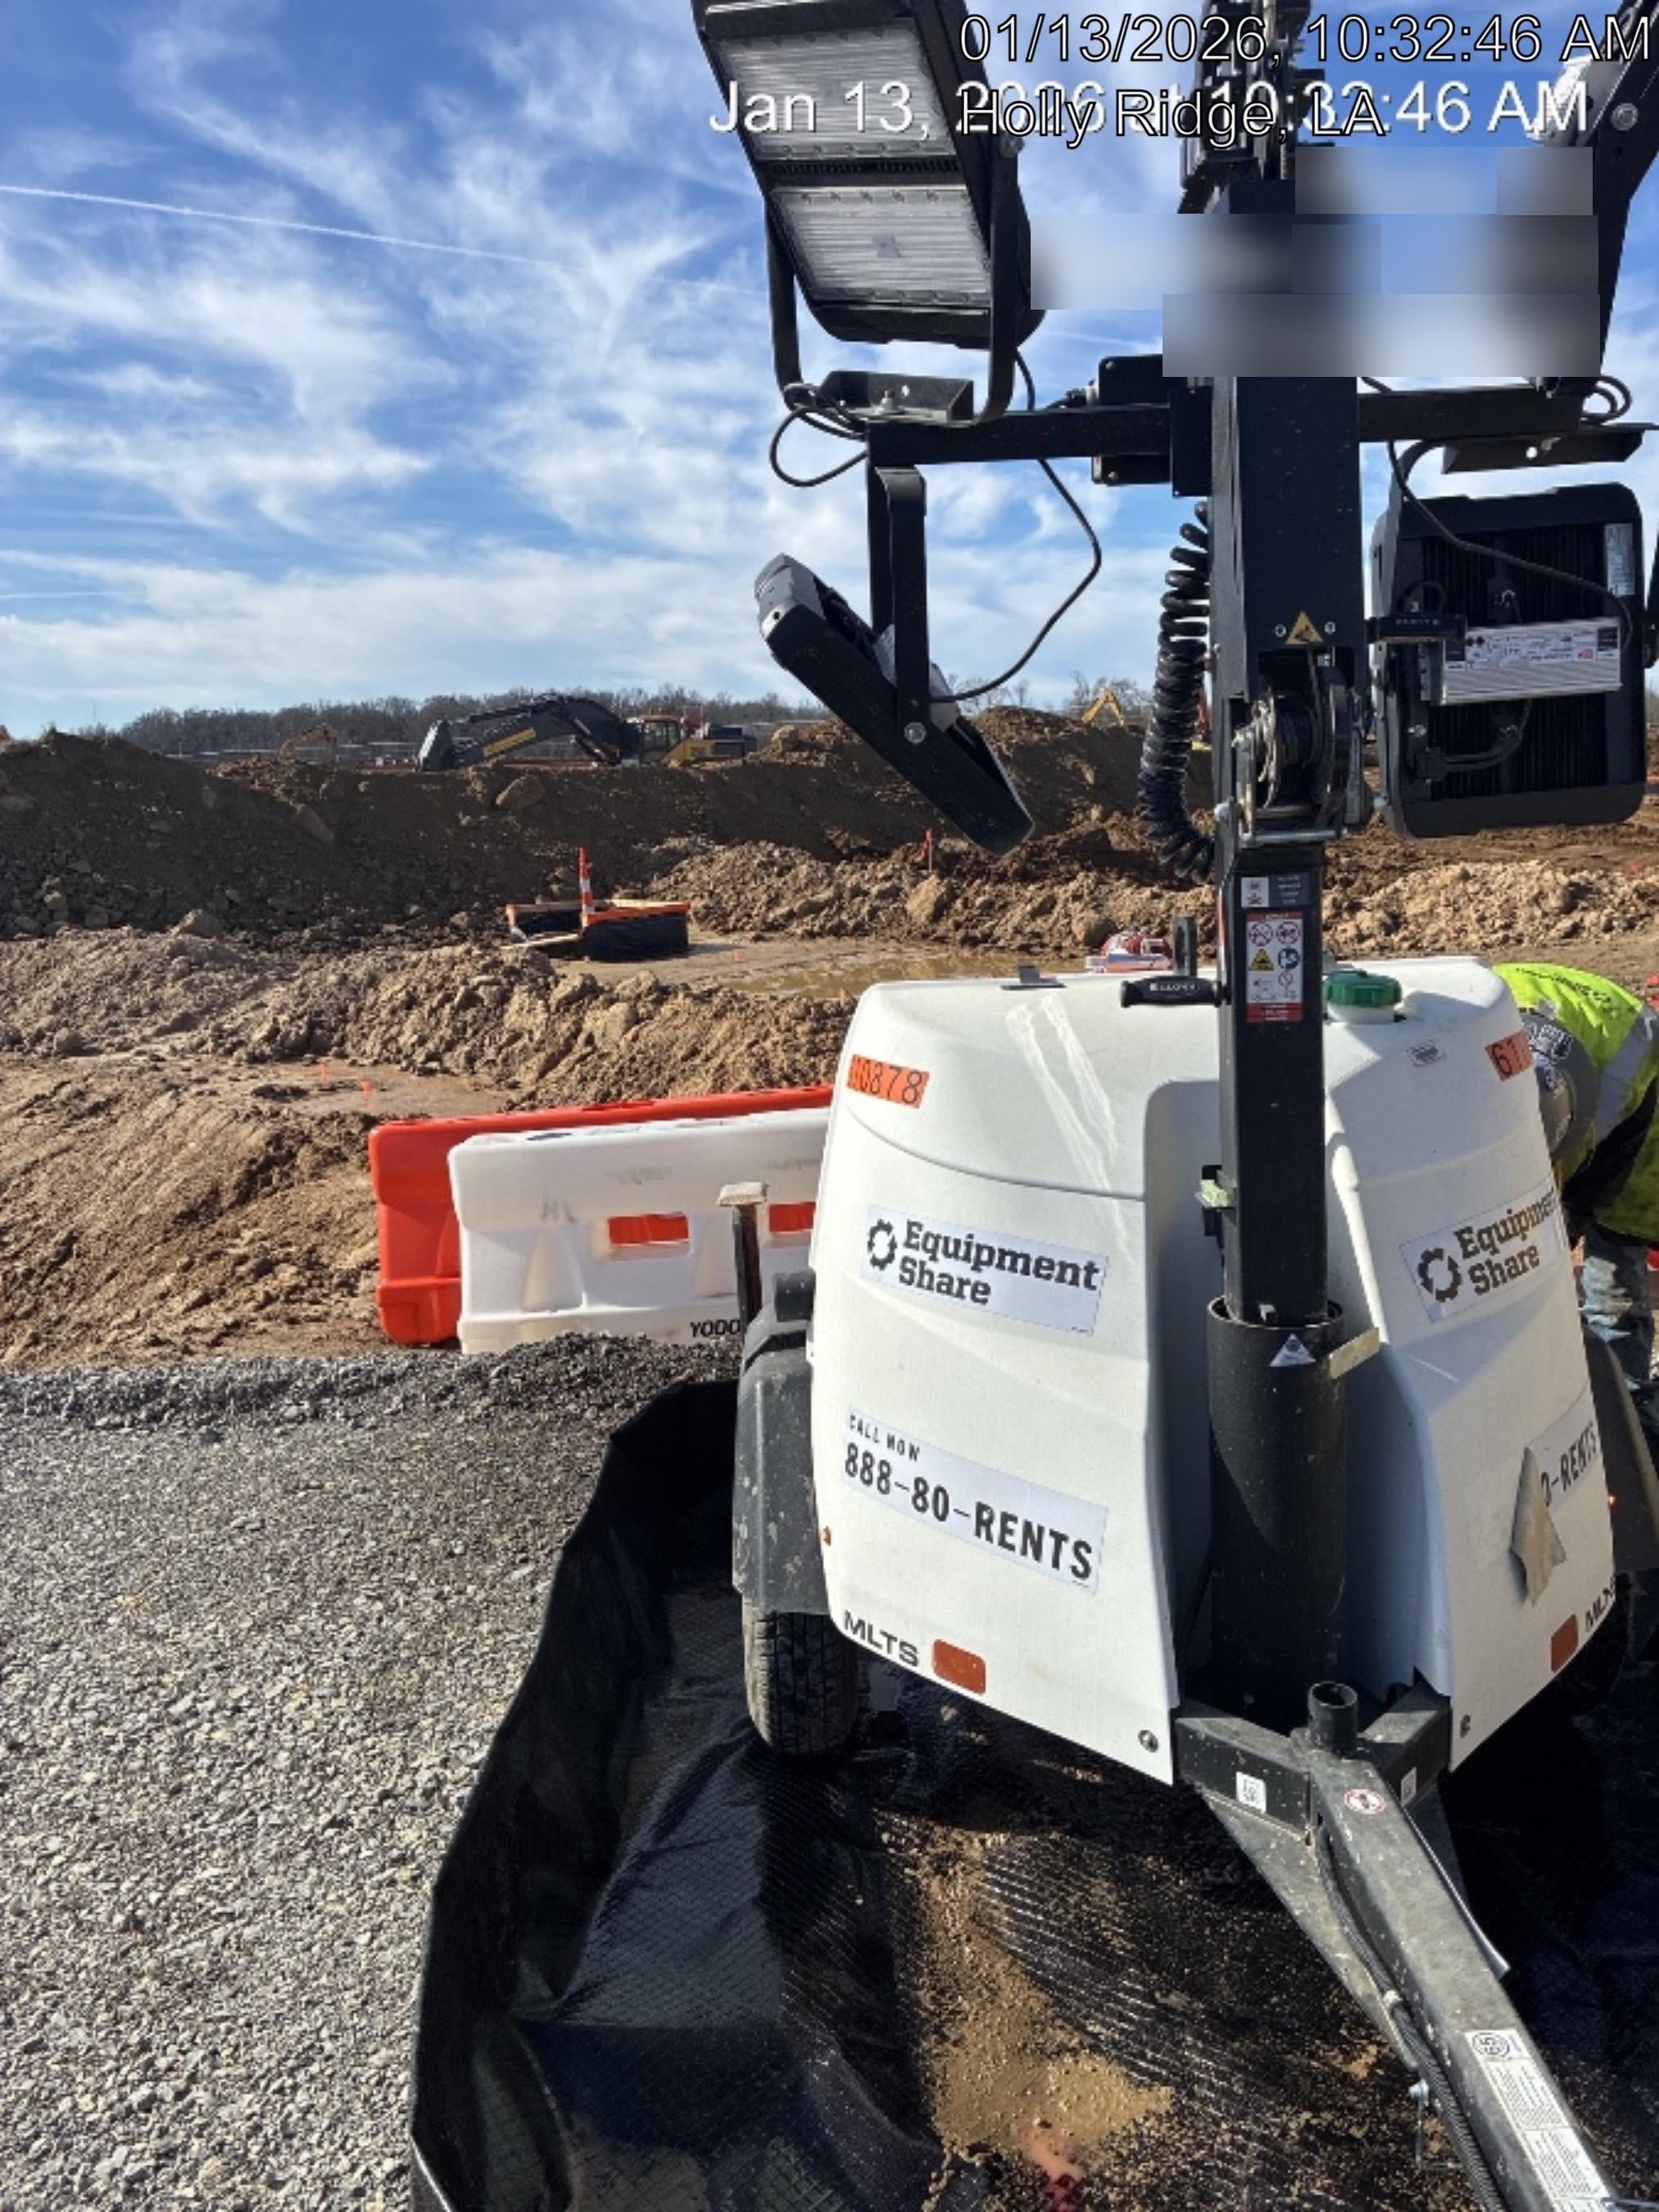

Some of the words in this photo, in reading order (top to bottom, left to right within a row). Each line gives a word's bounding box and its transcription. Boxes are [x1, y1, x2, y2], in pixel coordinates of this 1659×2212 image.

[899, 1255, 991, 1305] Share
[903, 1219, 1100, 1291] Equipment
[1468, 1244, 1540, 1296] Share
[849, 1413, 881, 1444] CALL
[886, 1433, 920, 1462] NOW
[845, 1442, 1092, 1580] 888-80-RENTS
[845, 1610, 918, 1667] MLTS
